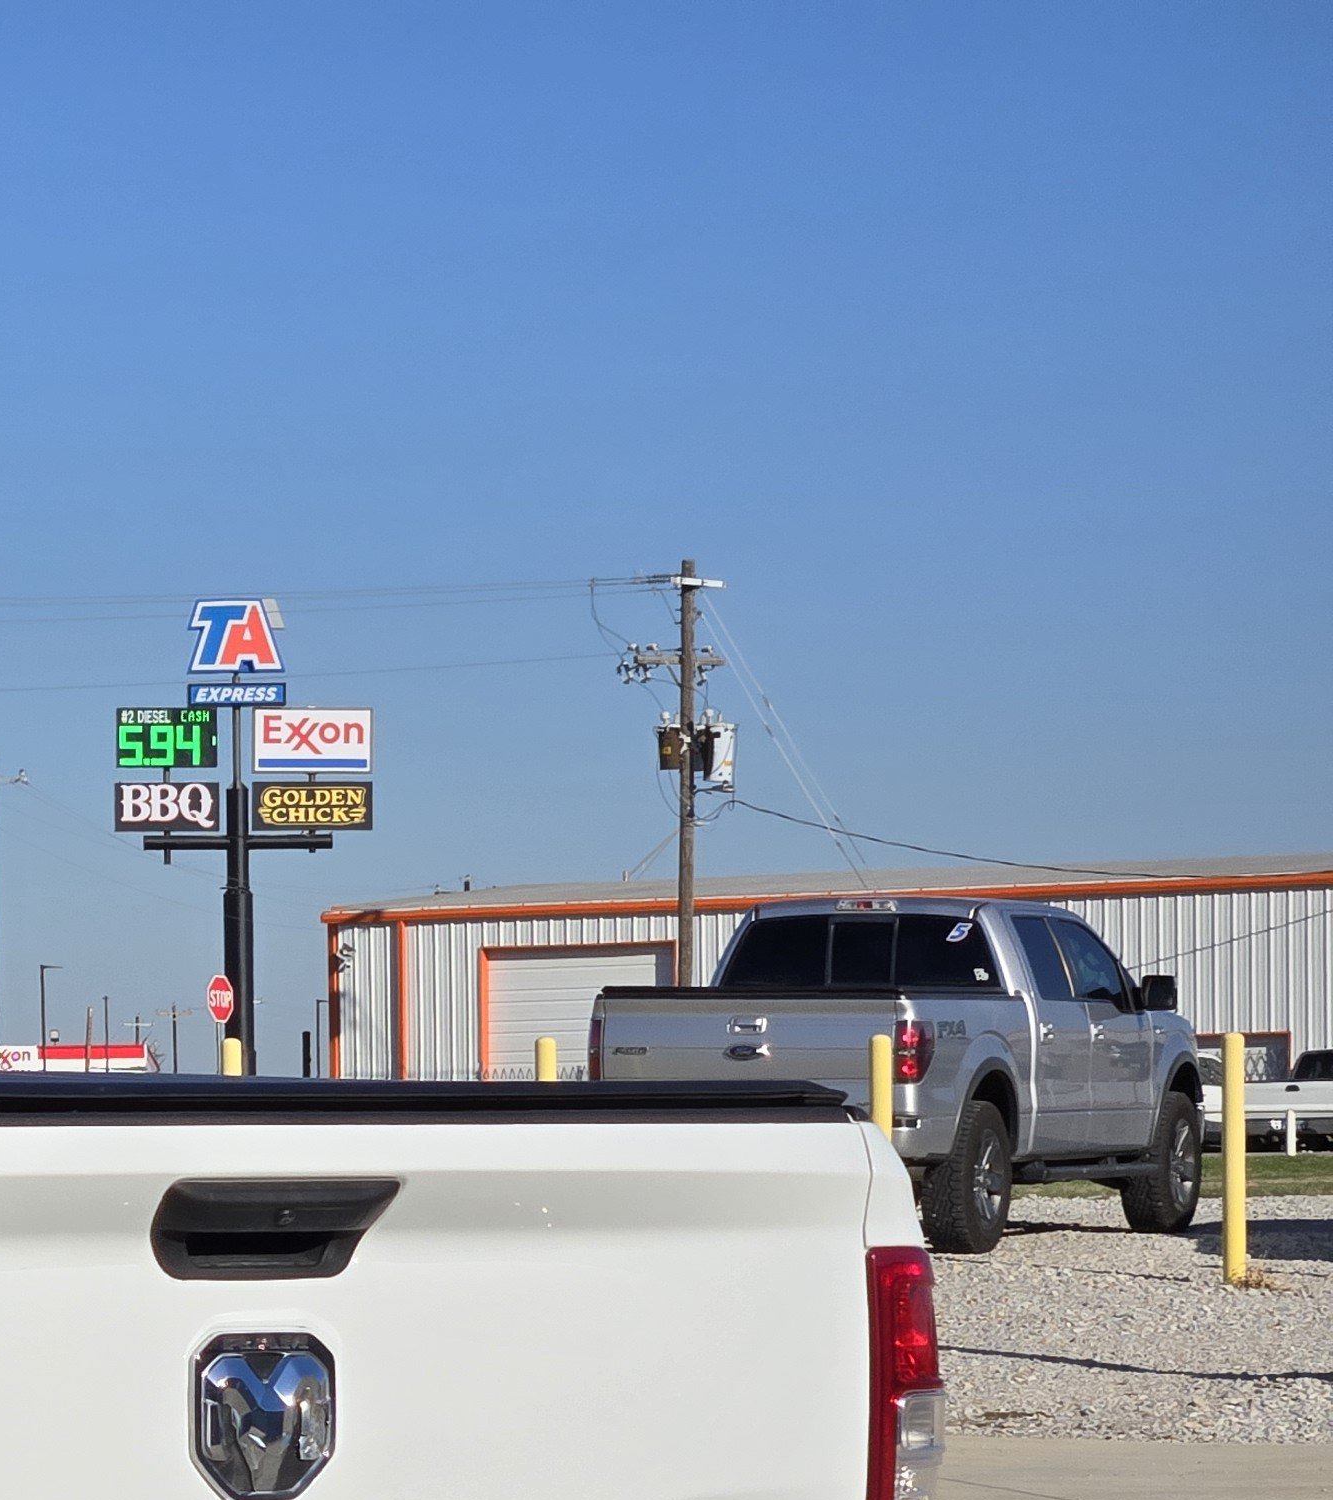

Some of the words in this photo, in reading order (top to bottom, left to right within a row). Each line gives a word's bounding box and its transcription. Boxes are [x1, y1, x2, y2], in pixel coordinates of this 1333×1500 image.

[193, 603, 280, 668] TA
[195, 686, 277, 703] EXPRESS
[121, 710, 134, 723] #2
[137, 710, 171, 723] DIESEL
[180, 710, 210, 722] CASH
[263, 715, 364, 755] Exxon
[119, 725, 200, 766] 5.94
[120, 784, 215, 828] BBQ
[263, 788, 363, 807] GOLDEN
[273, 807, 351, 822] CHICK
[209, 989, 231, 1008] STOP
